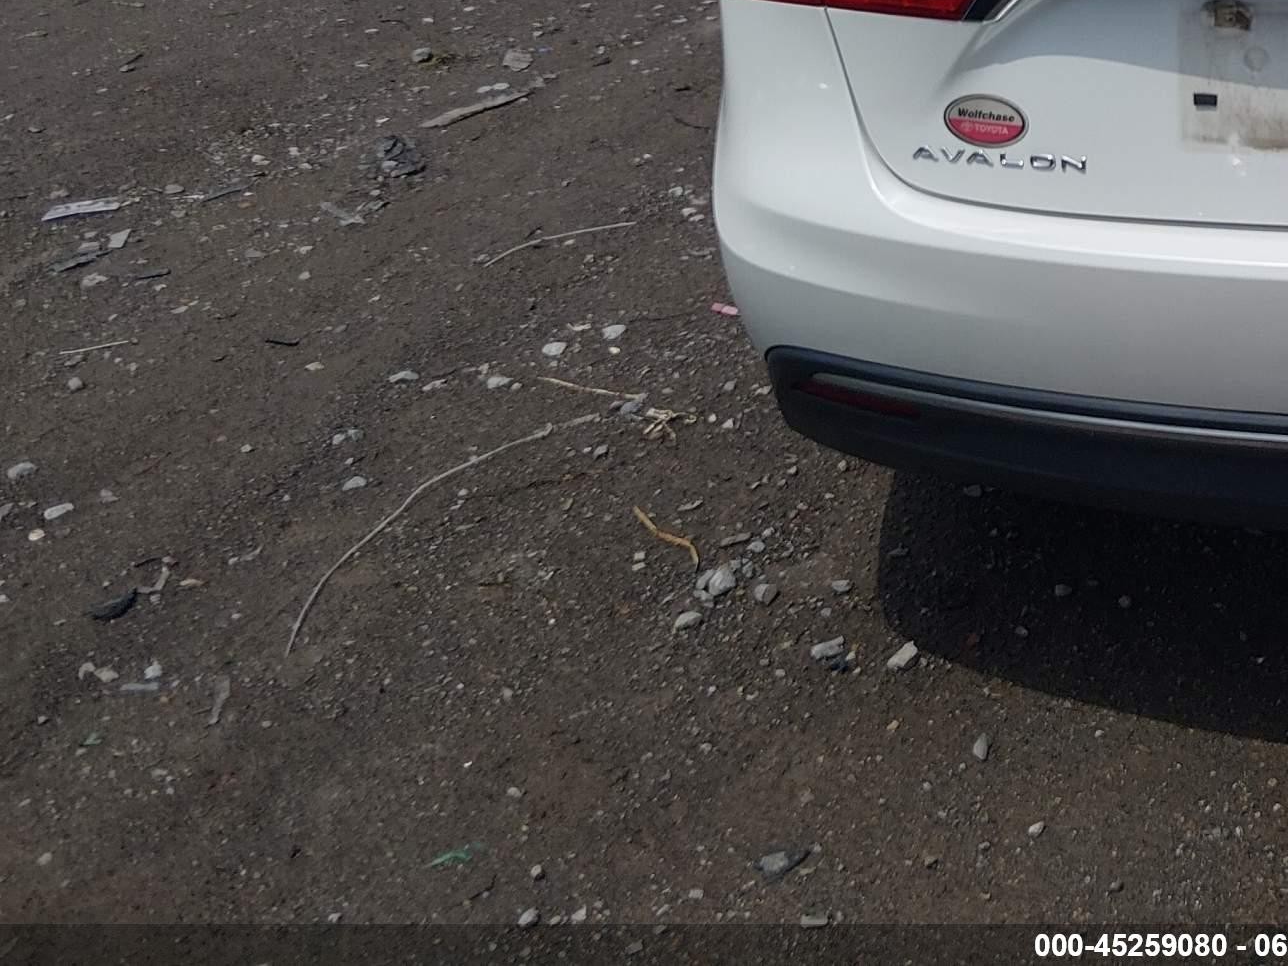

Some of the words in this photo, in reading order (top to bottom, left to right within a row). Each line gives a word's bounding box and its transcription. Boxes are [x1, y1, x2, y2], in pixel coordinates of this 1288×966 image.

[957, 107, 1016, 123] Wolfchase
[974, 122, 1009, 136] TOYOTA
[912, 145, 1087, 174] AVALON
